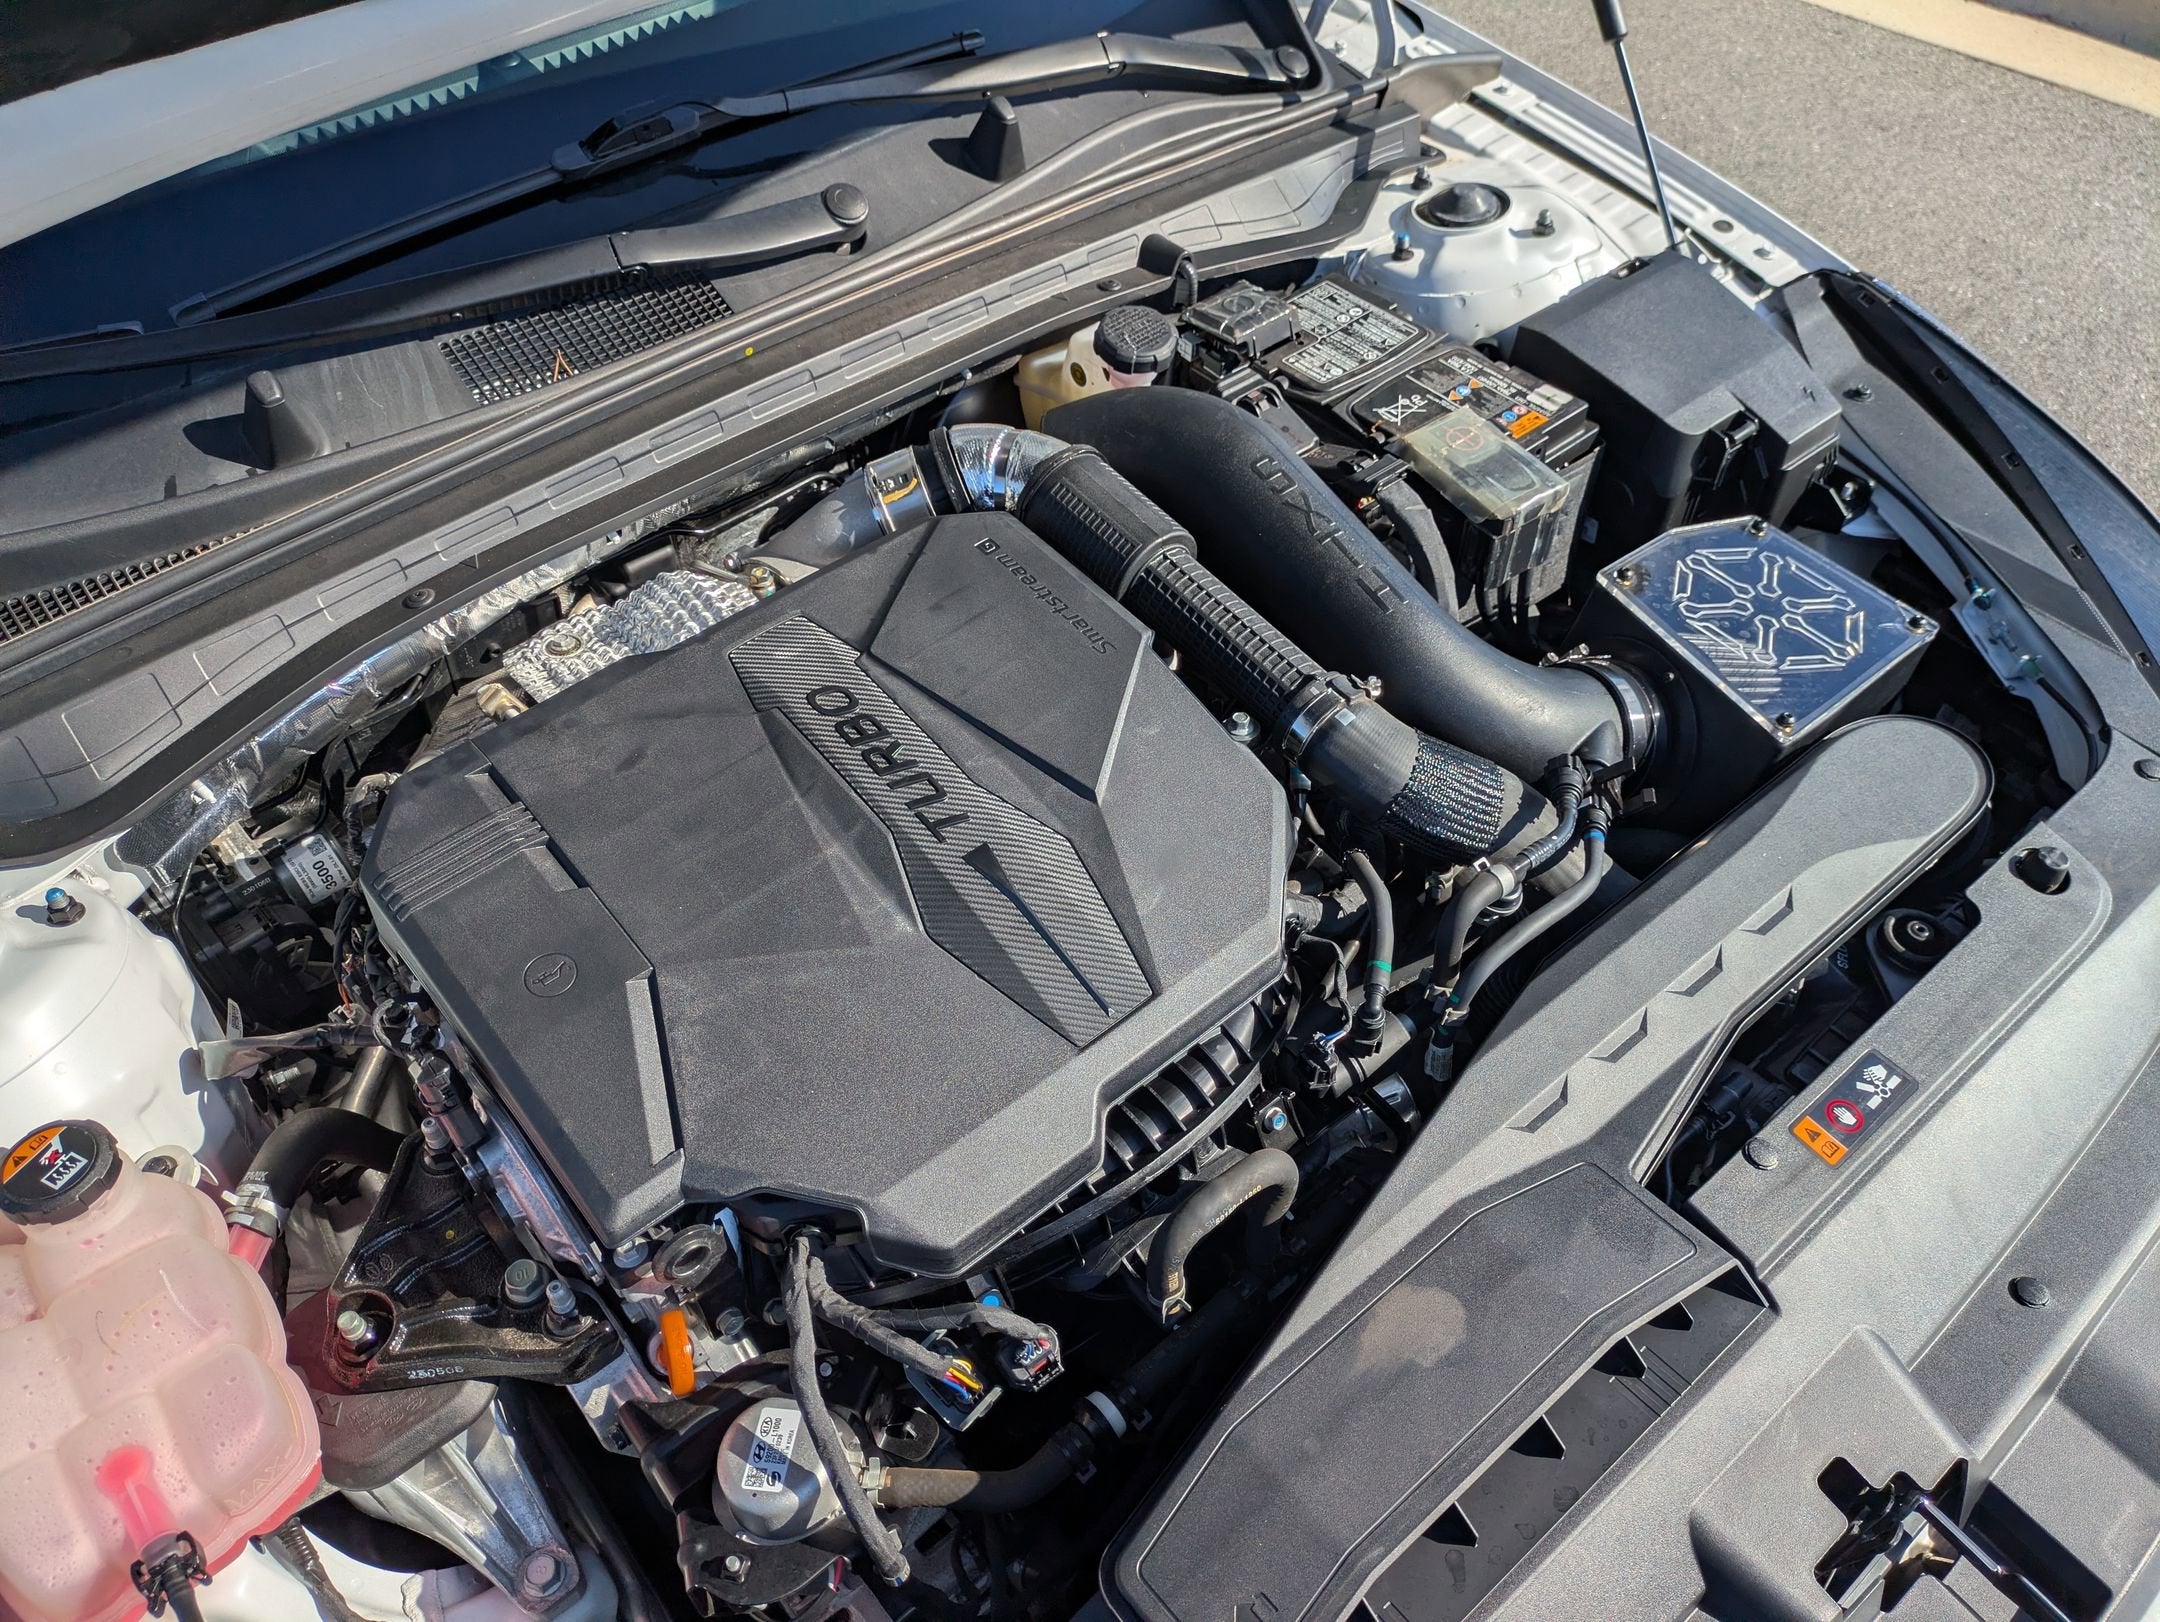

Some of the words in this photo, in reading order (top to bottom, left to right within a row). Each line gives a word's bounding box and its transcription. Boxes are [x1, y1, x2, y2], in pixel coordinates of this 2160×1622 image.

[1410, 393, 1428, 408] Pb
[996, 552, 1116, 655] Smartstream
[805, 685, 970, 843] TURBO
[312, 859, 338, 891] 3500
[760, 1419, 772, 1436] KIA
